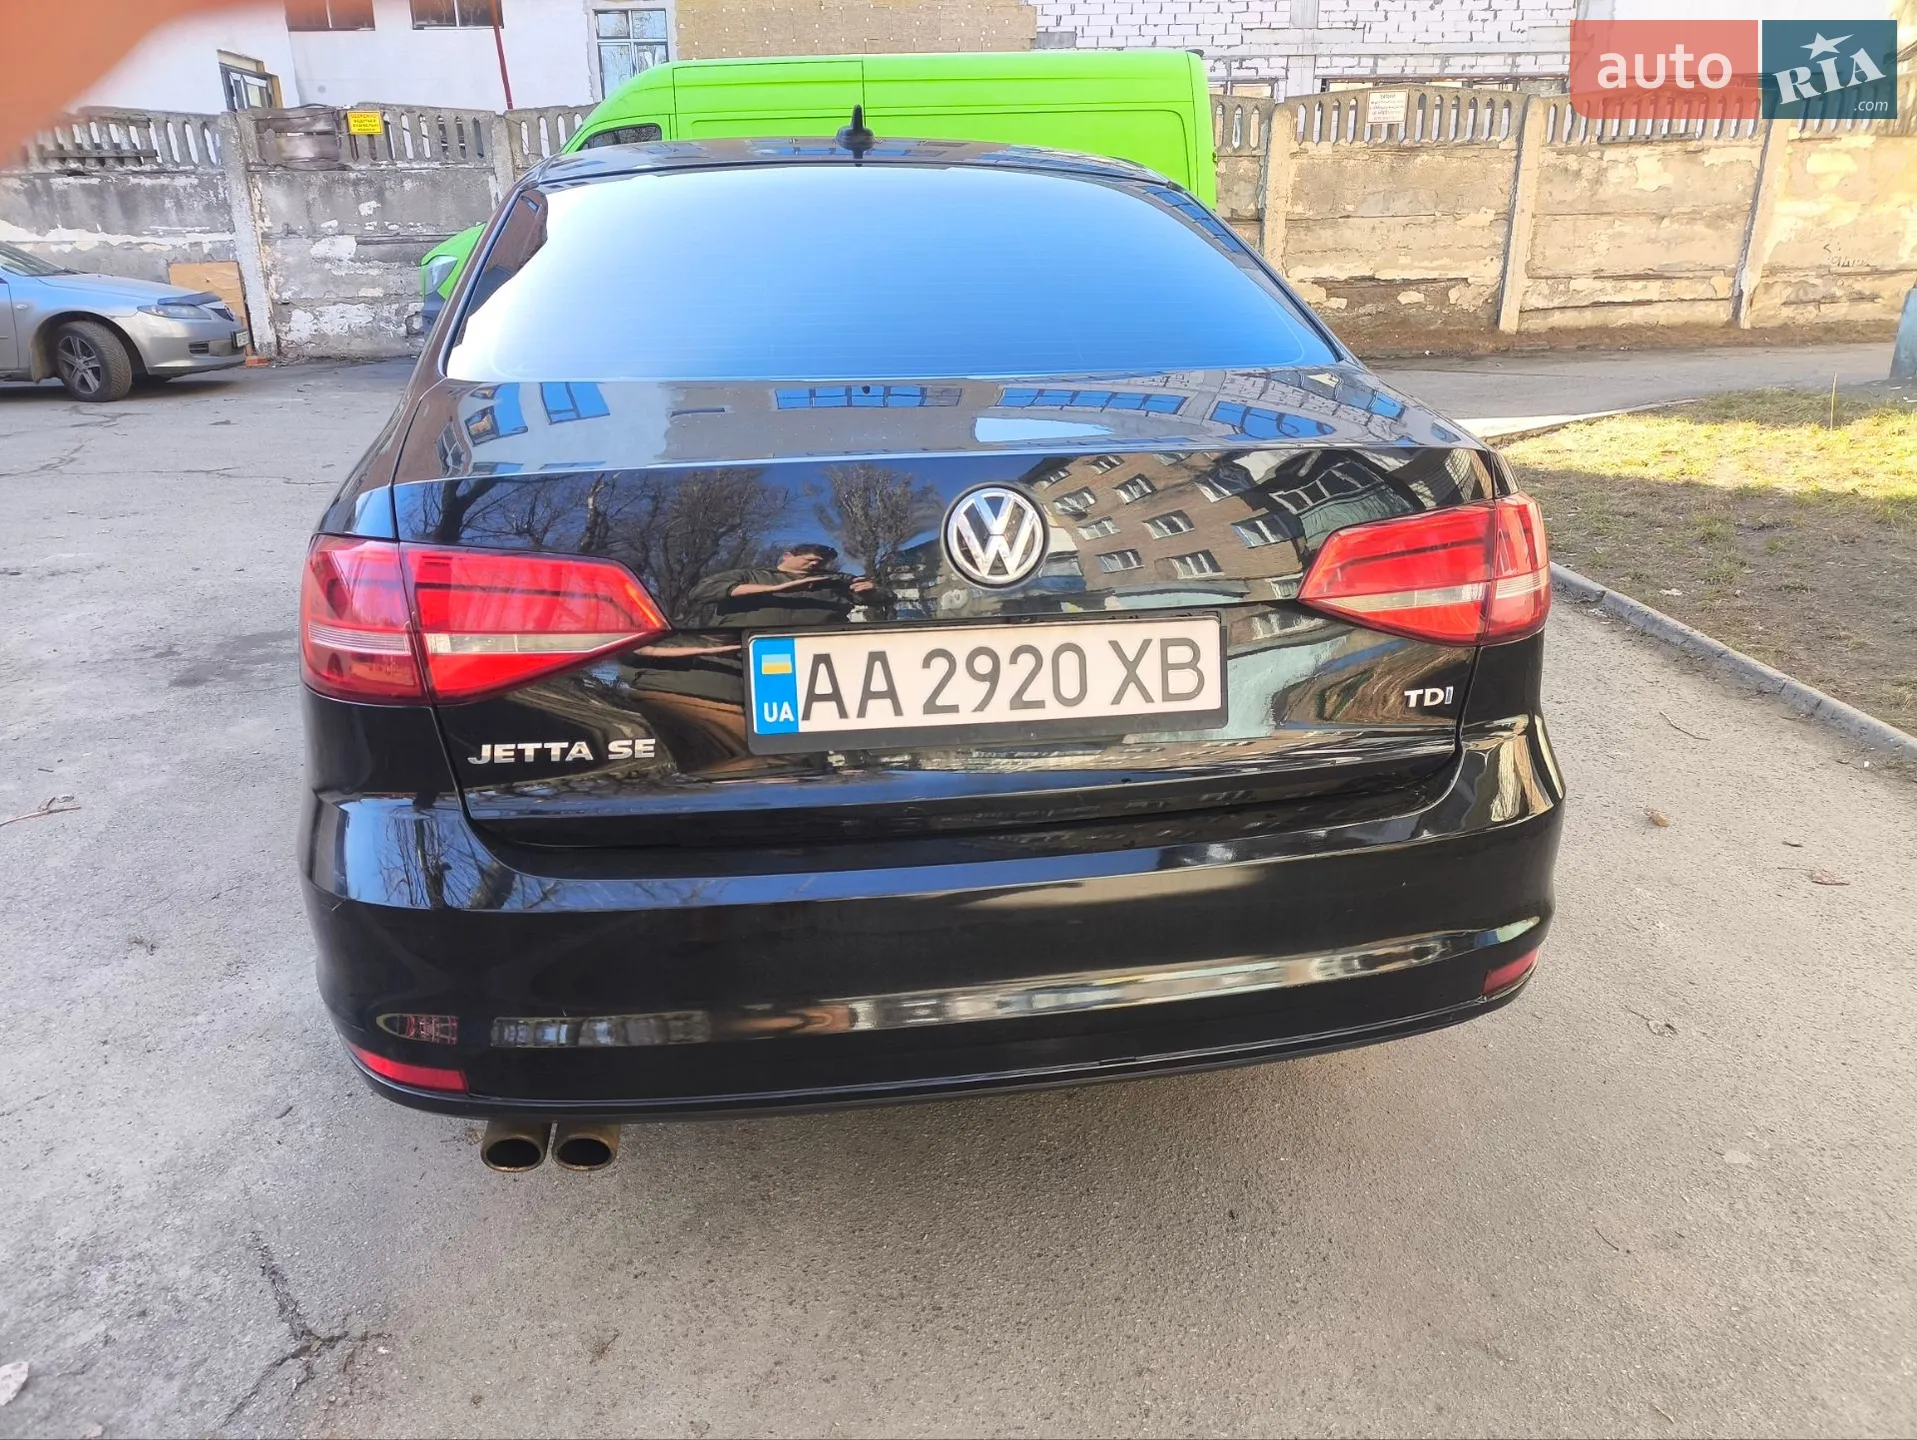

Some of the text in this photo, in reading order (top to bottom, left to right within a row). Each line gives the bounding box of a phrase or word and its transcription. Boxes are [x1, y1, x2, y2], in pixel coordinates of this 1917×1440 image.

[801, 637, 1205, 720] AA 2920 XB
[1404, 686, 1454, 708] TDI
[764, 702, 795, 723] UA
[467, 738, 656, 764] JETTA SE
